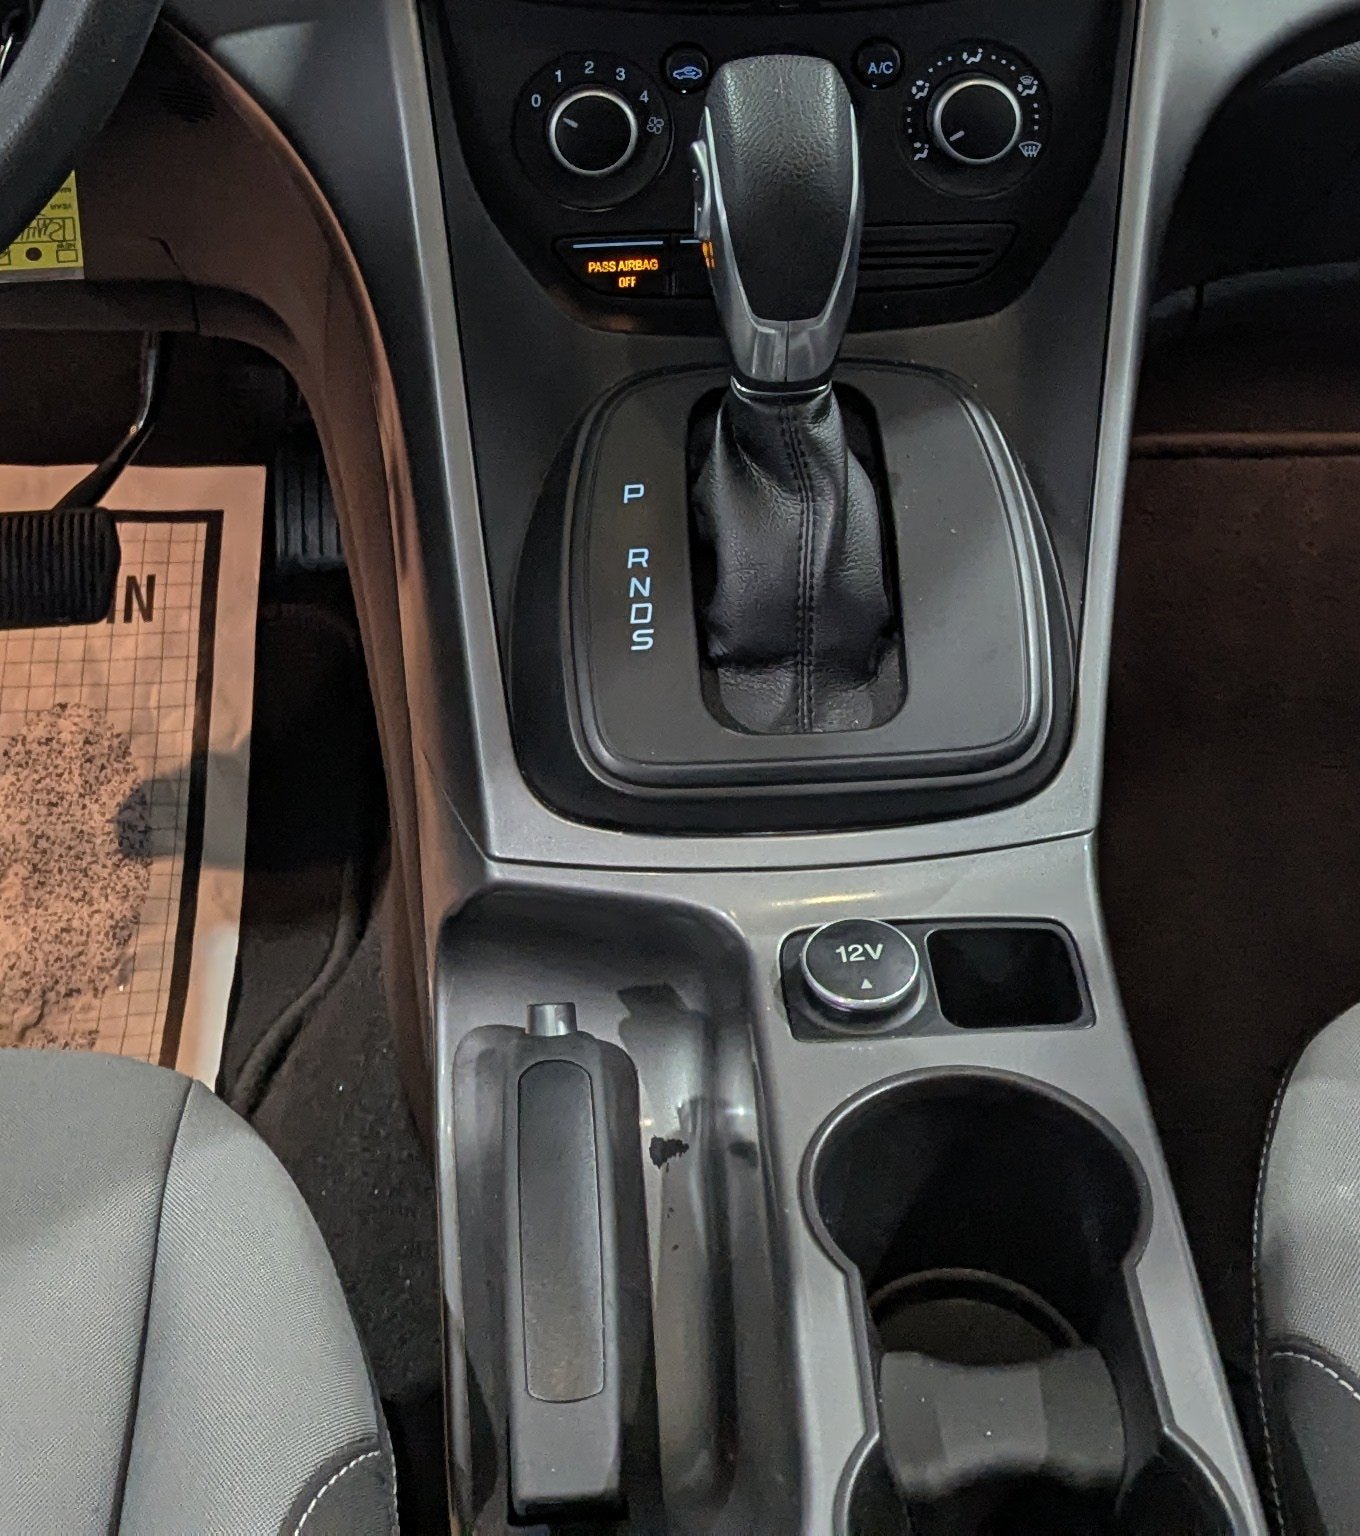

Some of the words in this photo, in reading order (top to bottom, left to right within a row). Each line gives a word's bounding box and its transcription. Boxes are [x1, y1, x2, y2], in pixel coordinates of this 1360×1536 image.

[584, 61, 594, 74] 2
[616, 67, 626, 81] 3
[867, 61, 894, 74] A/C
[555, 69, 563, 83] 1
[531, 94, 541, 107] 0
[640, 89, 650, 103] 4
[588, 261, 616, 273] PASS
[617, 259, 659, 272] AIRBAG
[619, 277, 636, 289] OFF
[623, 483, 645, 504] P
[627, 548, 650, 569] R
[629, 576, 651, 598] N
[630, 602, 653, 625] D
[630, 628, 655, 651] S
[835, 943, 883, 963] 12V
